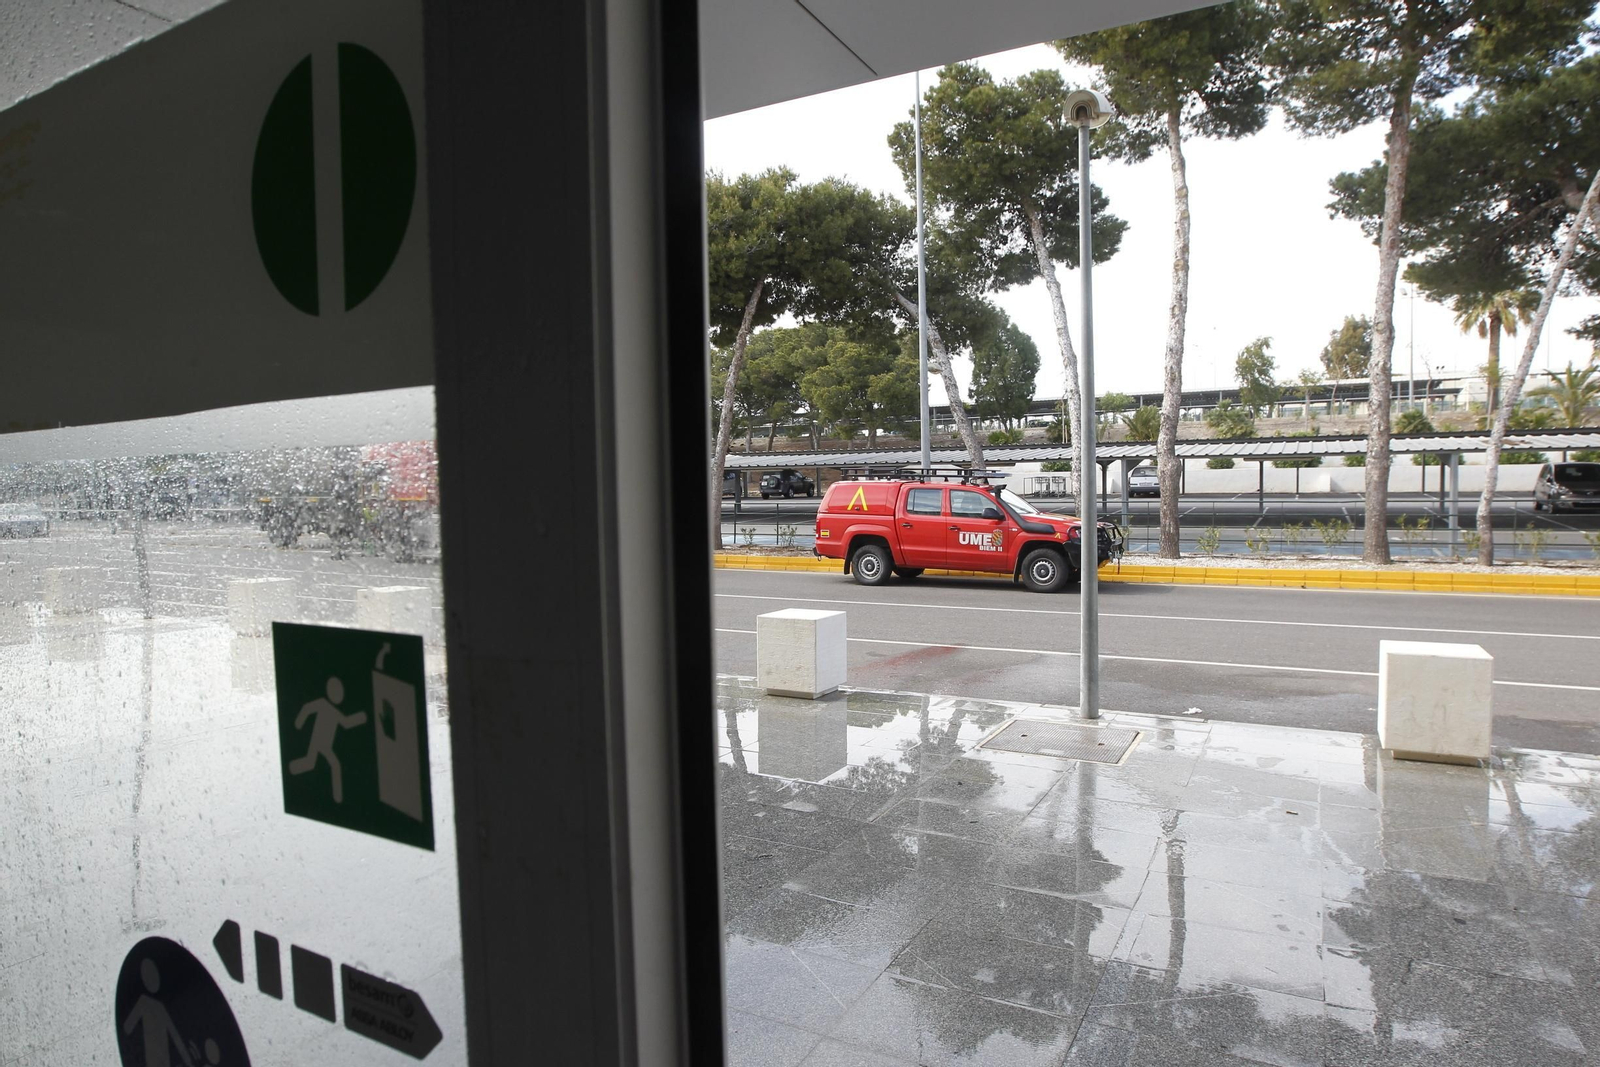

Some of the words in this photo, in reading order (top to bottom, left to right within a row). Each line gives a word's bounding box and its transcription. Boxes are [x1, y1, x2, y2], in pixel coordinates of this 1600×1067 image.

[959, 532, 993, 545] UME
[347, 972, 395, 1007] besam
[379, 1019, 415, 1043] ABLOY
